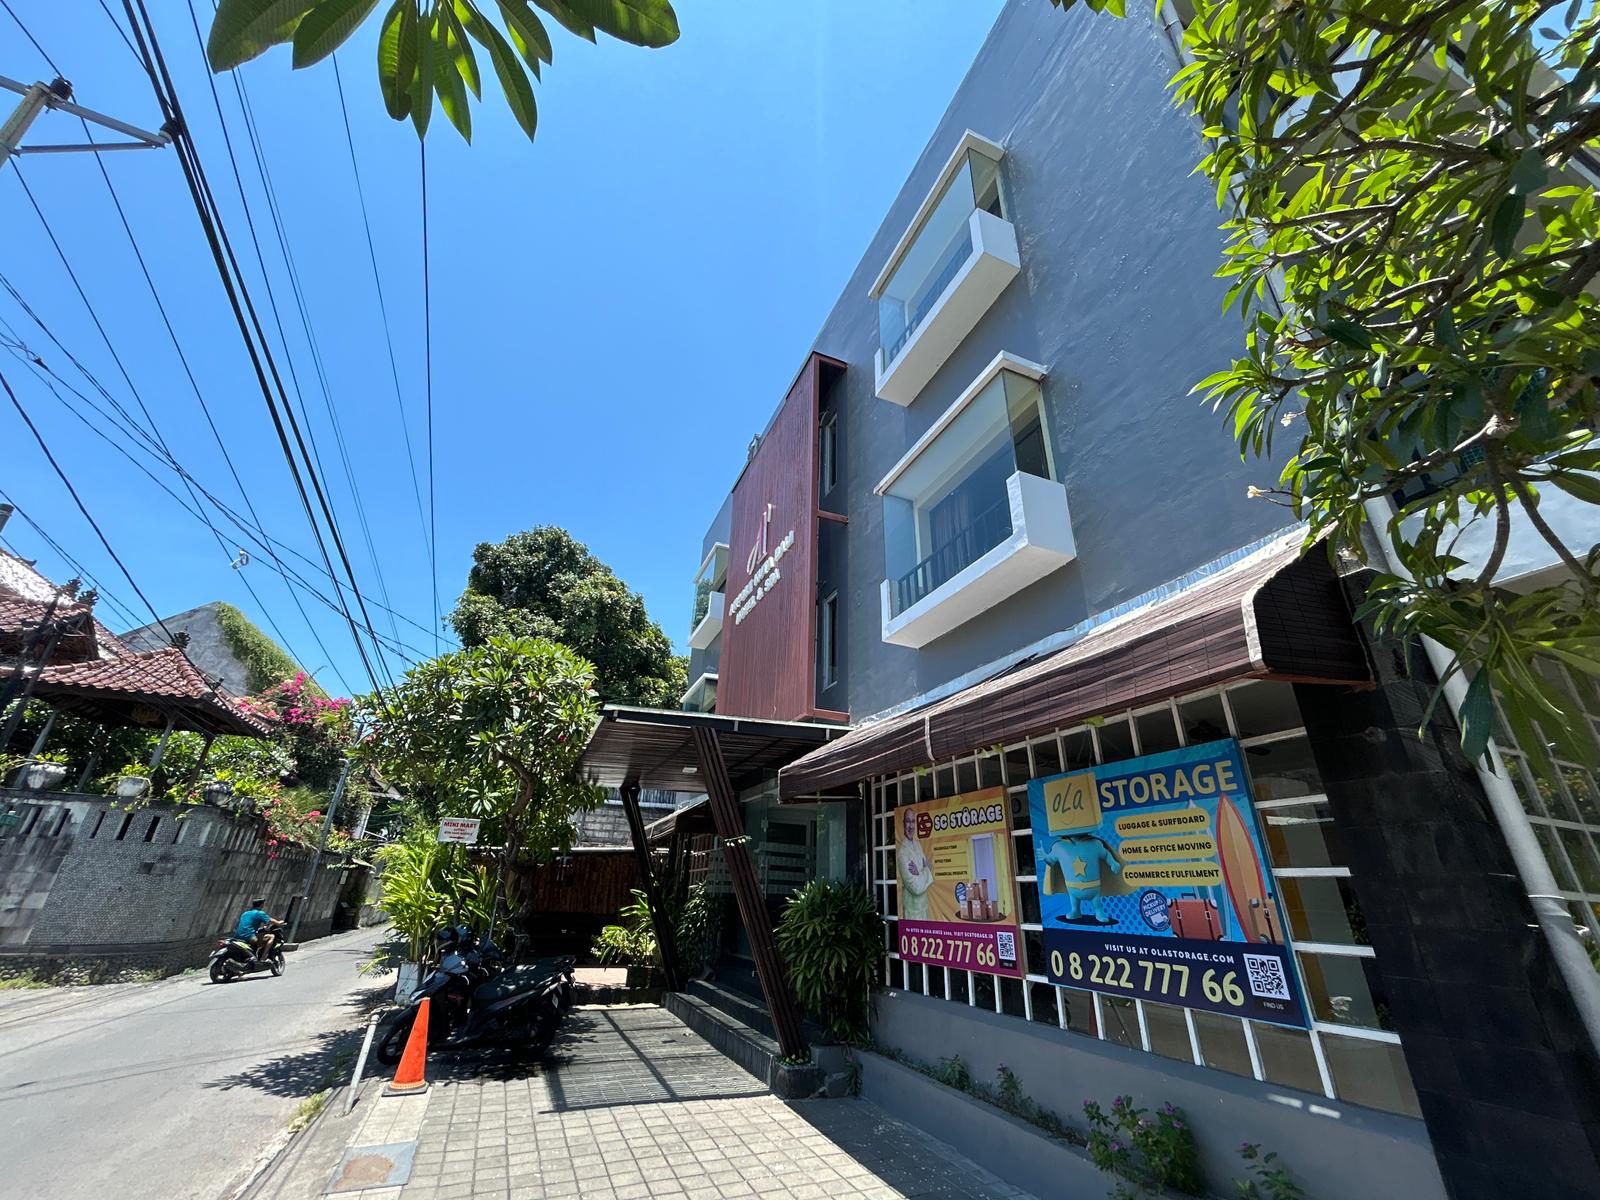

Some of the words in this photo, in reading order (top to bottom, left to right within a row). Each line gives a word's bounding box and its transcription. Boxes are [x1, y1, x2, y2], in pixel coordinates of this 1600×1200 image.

[1101, 760, 1238, 808] STORAGE
[934, 814, 948, 831] SC
[1118, 821, 1150, 831] LUGGAGE
[1158, 815, 1205, 827] SURFBOARD
[1122, 846, 1142, 854] HOME
[1150, 843, 1176, 852] OFFICE
[1177, 842, 1212, 851] MOVING
[1124, 871, 1170, 879] ECOMMERCE
[1171, 869, 1219, 878] FULFILMENT
[1145, 904, 1166, 917] DELIVERY
[901, 935, 908, 954] 0
[911, 936, 918, 956] 8
[921, 937, 944, 960] 222
[946, 940, 971, 963] 777
[976, 943, 996, 967] 66
[1104, 943, 1124, 953] VISIT
[1126, 946, 1137, 954] US
[1139, 947, 1149, 955] AT
[1151, 948, 1235, 964] OLASTORAGE.COM
[1051, 950, 1064, 978] 0
[1069, 952, 1083, 980] 8
[1087, 954, 1134, 989] 222
[1138, 960, 1190, 998] 777
[1202, 968, 1245, 1006] 66
[1276, 1002, 1284, 1010] US
